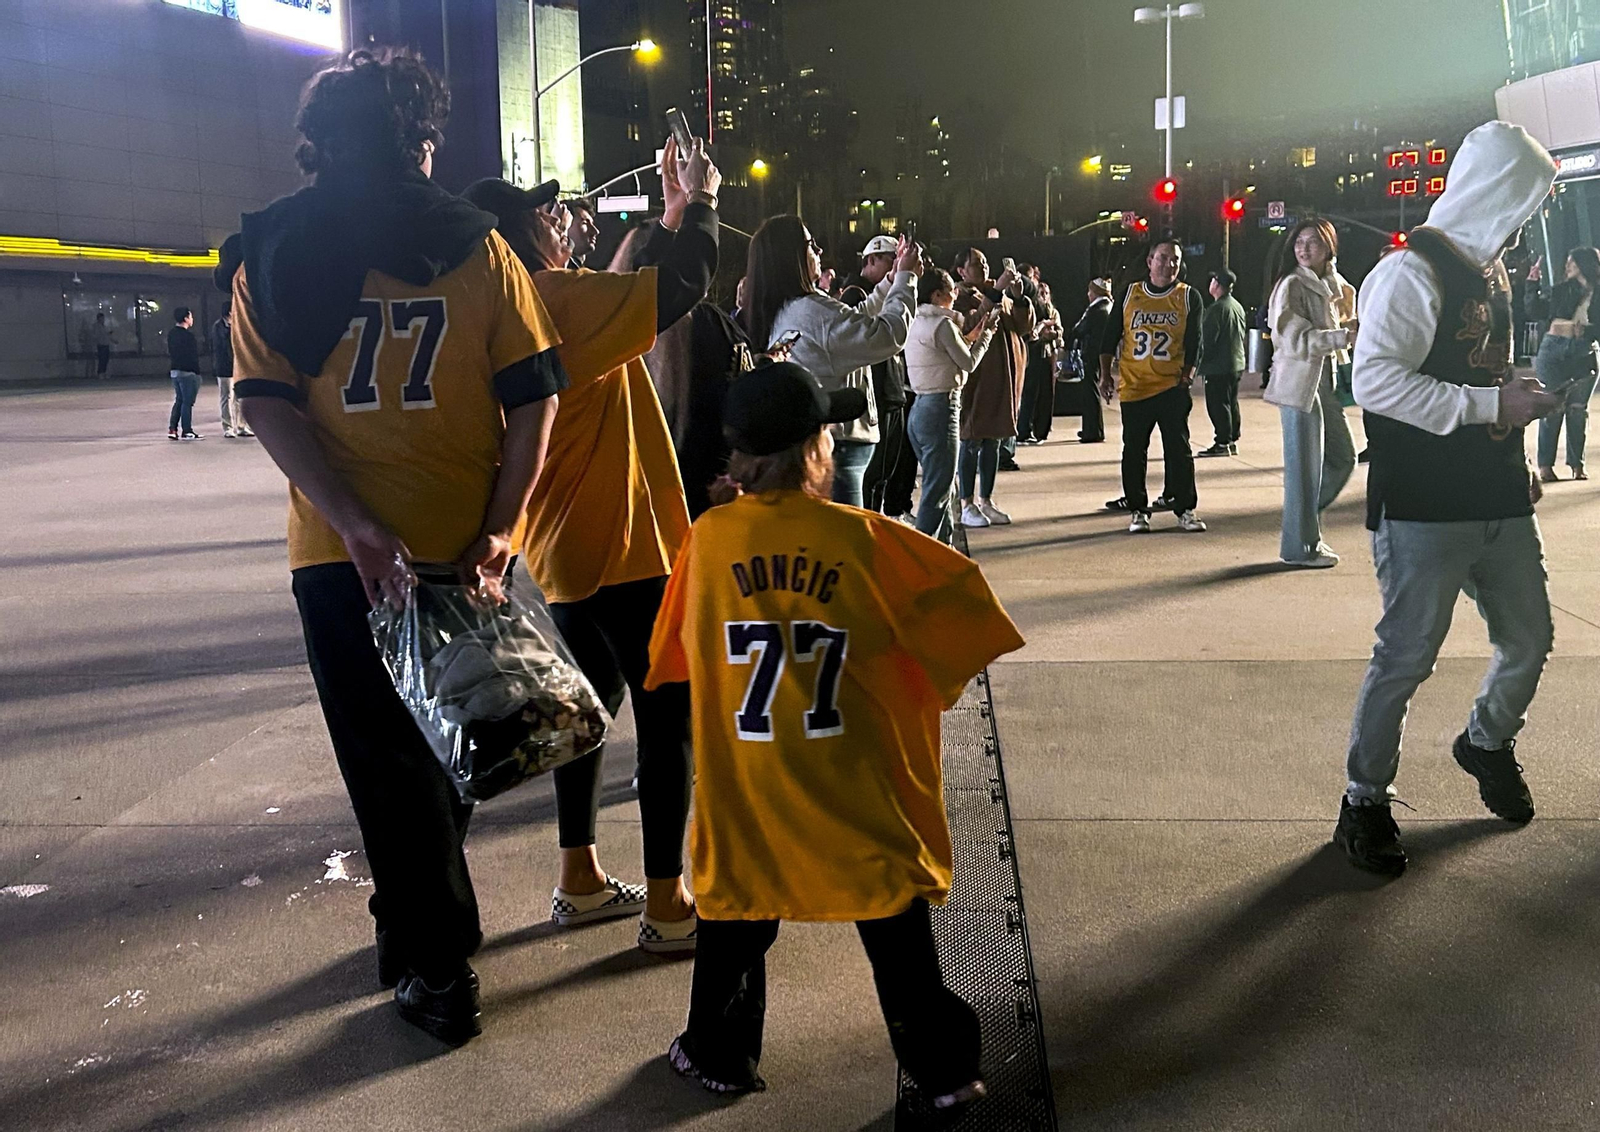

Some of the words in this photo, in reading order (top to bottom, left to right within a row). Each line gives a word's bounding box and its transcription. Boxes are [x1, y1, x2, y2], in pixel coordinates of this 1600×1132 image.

[1130, 309, 1179, 330] LAKERS
[1132, 329, 1172, 361] 32
[340, 296, 448, 413] 77
[731, 546, 844, 604] DONČIĆ
[724, 620, 849, 742] 77
